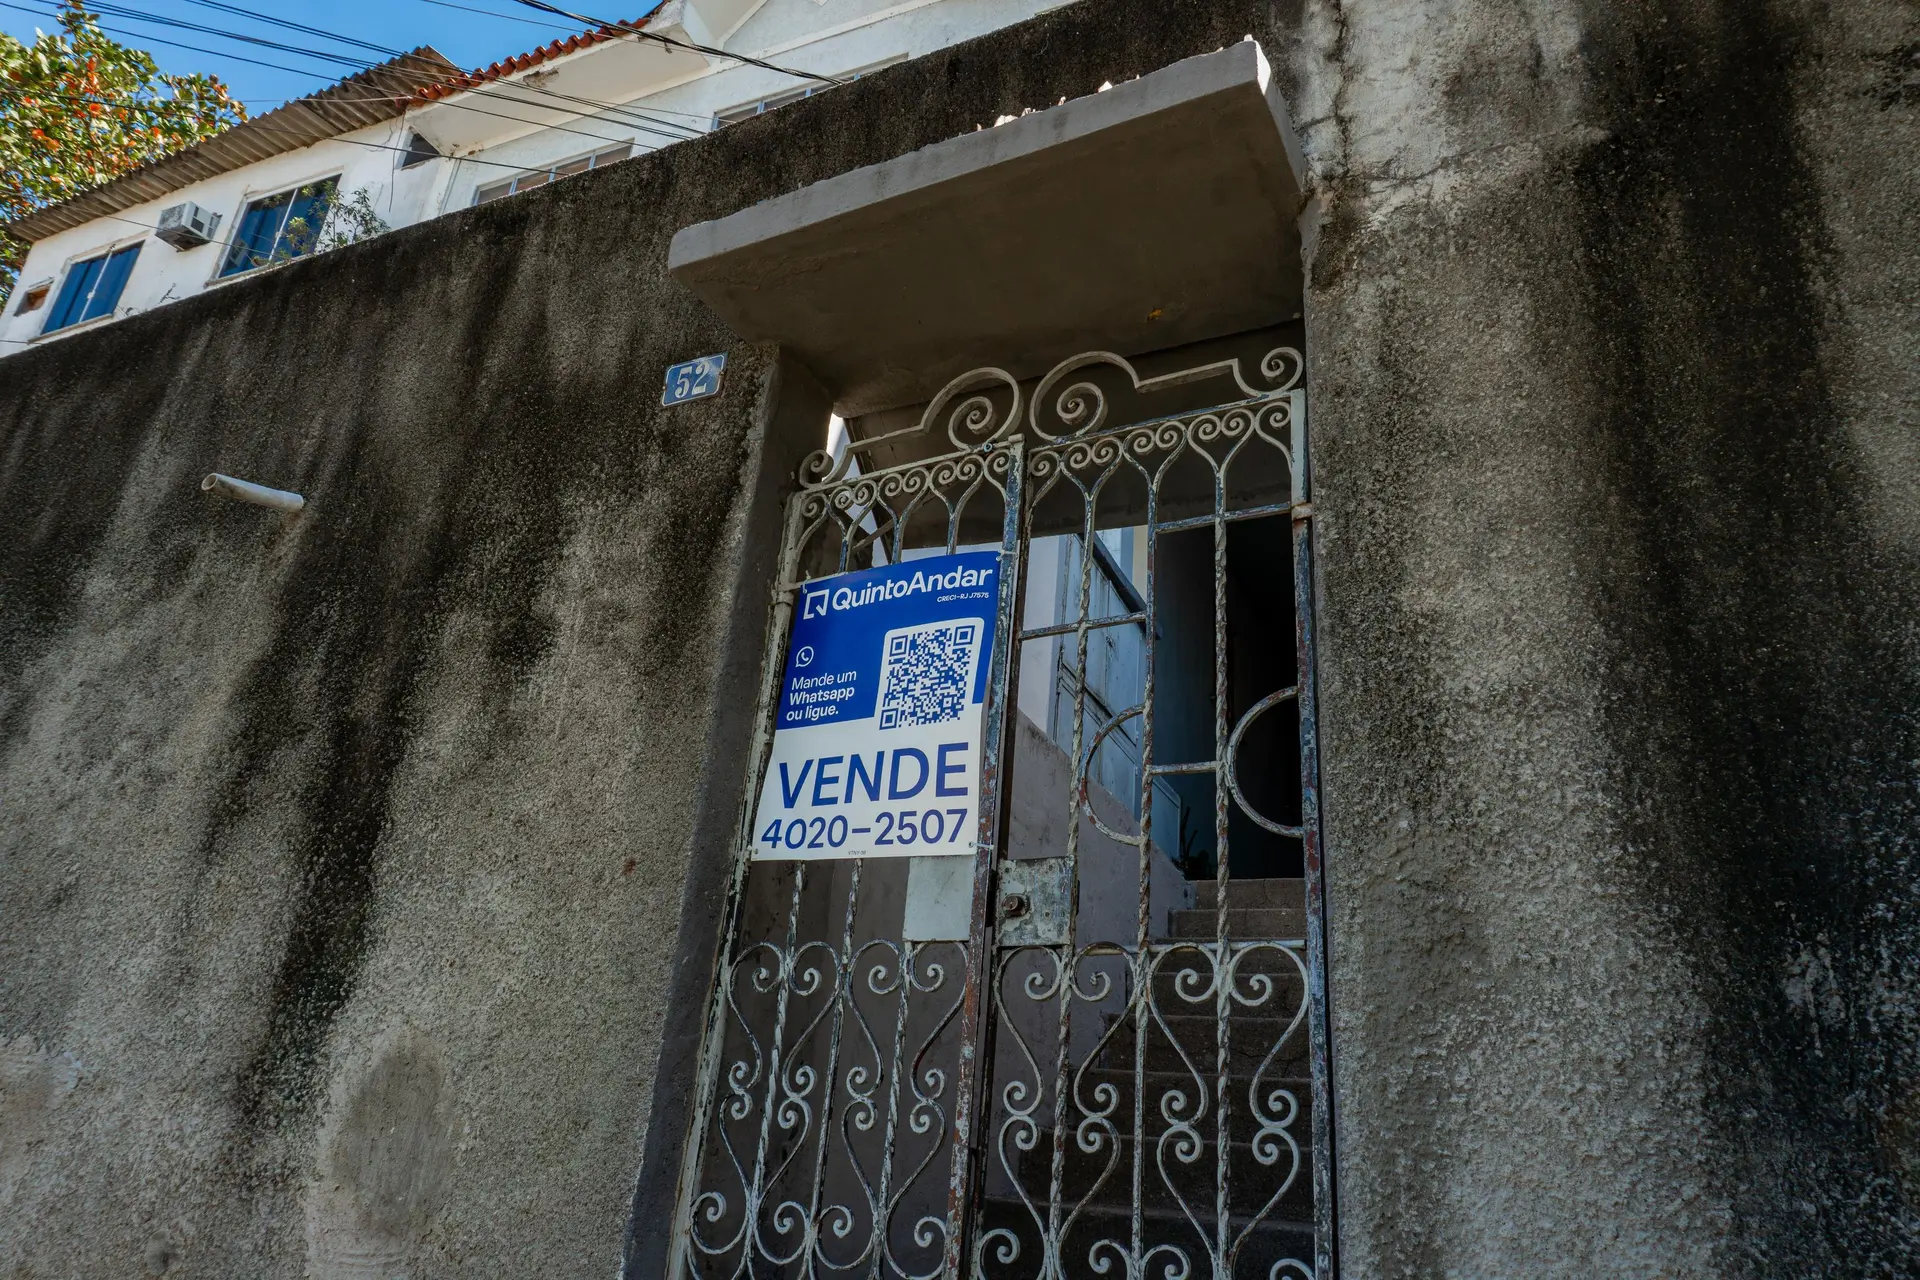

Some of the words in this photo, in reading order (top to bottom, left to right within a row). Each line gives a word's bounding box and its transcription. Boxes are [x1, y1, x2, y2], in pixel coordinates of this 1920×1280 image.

[674, 361, 709, 399] 52
[832, 565, 993, 611] QuintoAndar
[789, 686, 855, 706] Whatsapp
[791, 672, 835, 690] Mande
[837, 670, 857, 684] um
[786, 709, 803, 721] ou
[804, 704, 839, 721] ligue.
[779, 742, 969, 809] VENDE
[761, 808, 968, 849] 4020-2507
